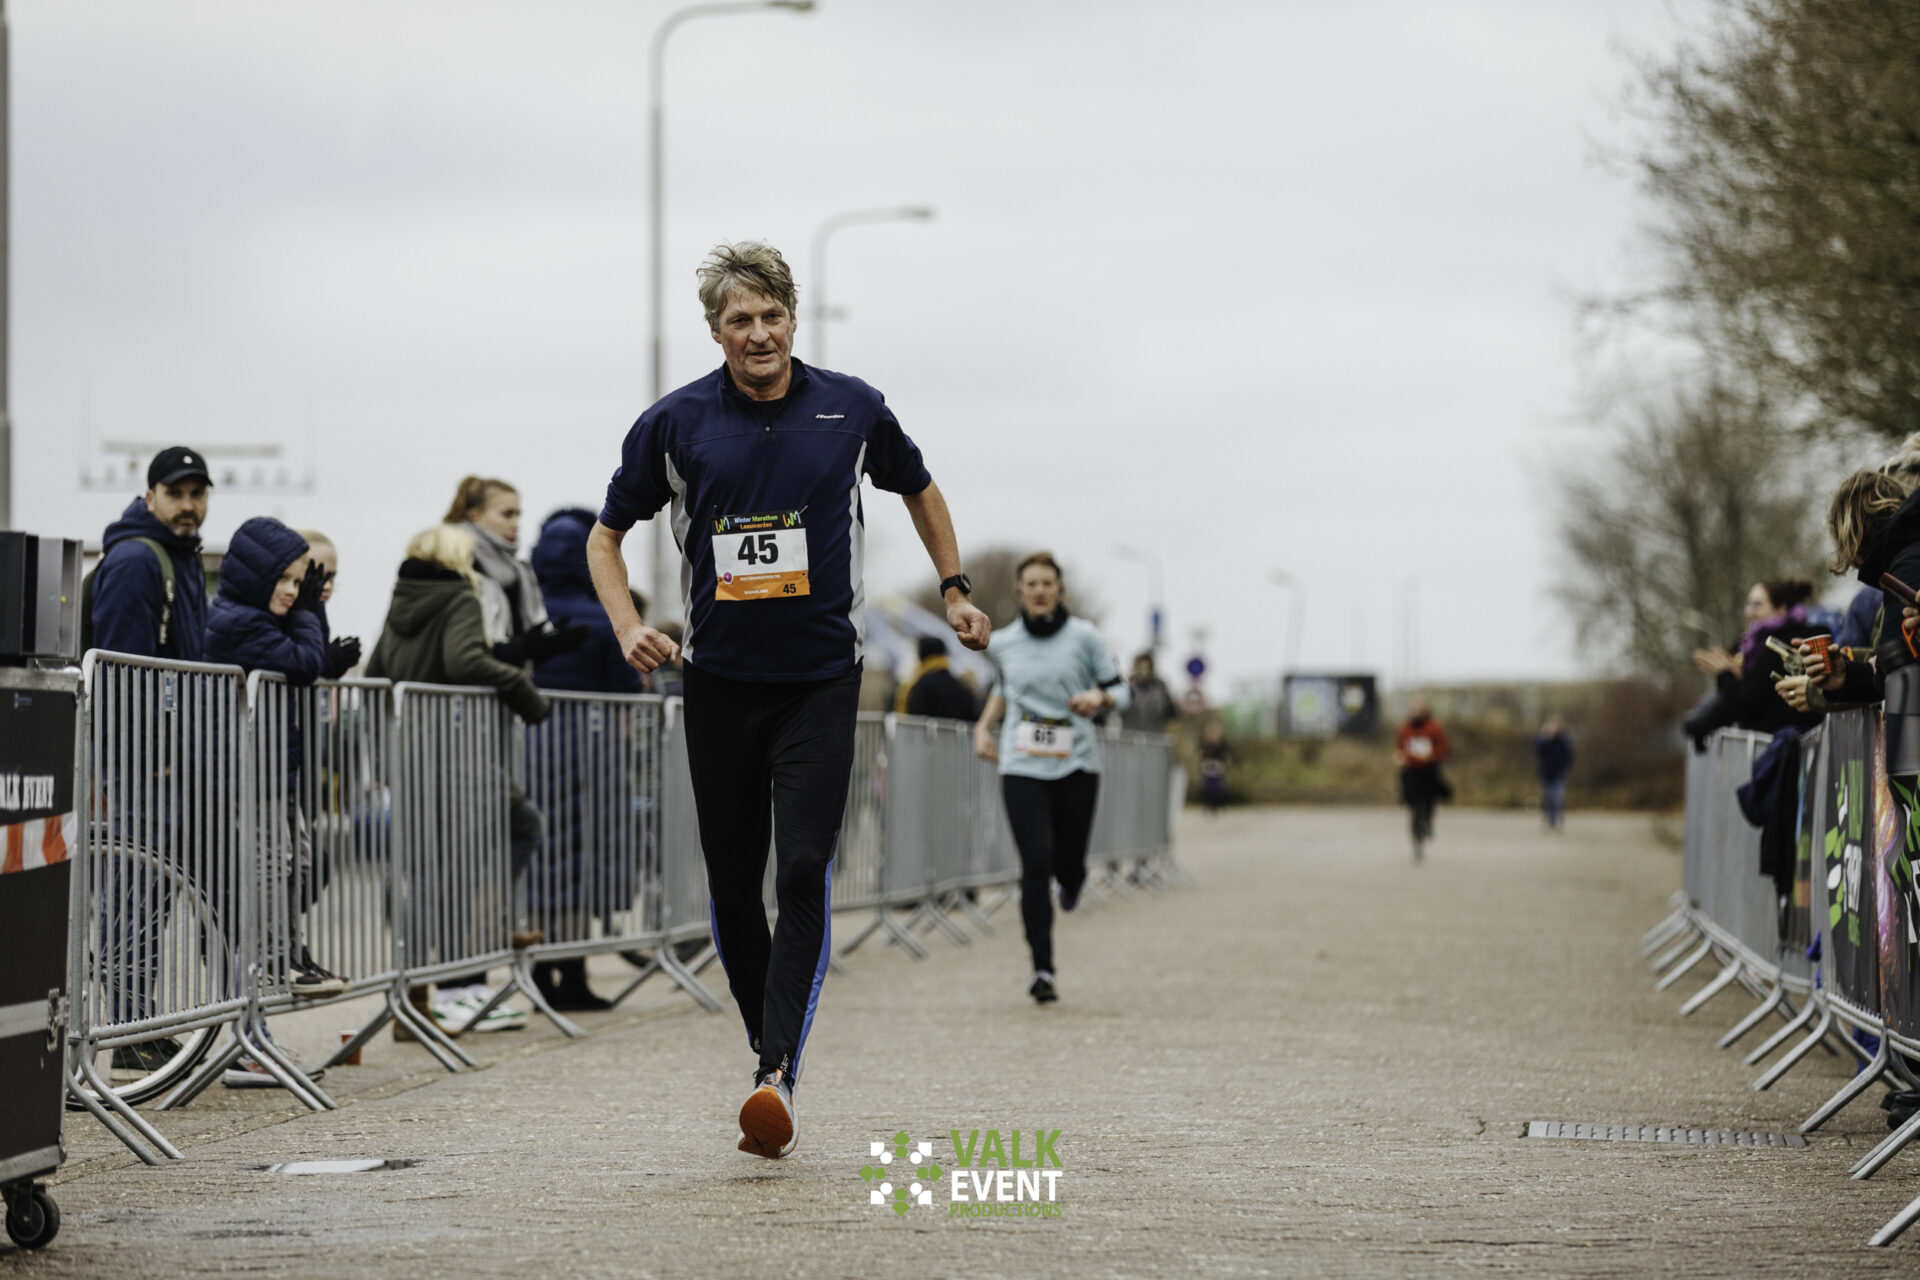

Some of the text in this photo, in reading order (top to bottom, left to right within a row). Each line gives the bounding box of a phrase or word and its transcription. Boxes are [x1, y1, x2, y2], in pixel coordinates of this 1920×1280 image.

[734, 514, 778, 524] Winter Marathon
[737, 533, 779, 566] 45
[782, 583, 797, 594] 45
[0, 773, 20, 811] ALK
